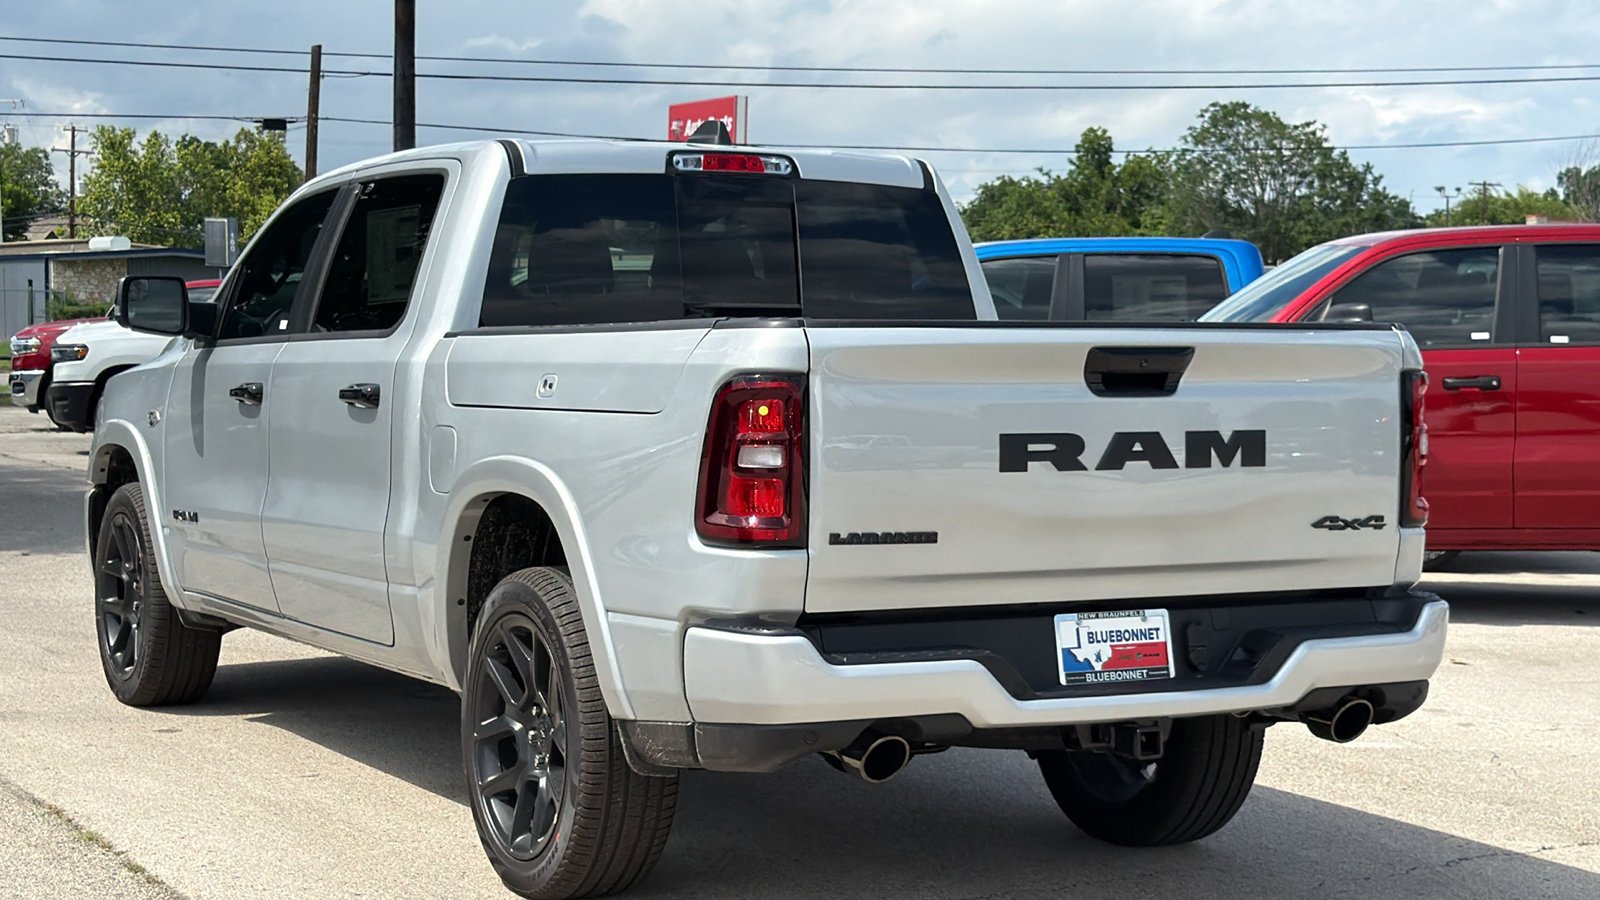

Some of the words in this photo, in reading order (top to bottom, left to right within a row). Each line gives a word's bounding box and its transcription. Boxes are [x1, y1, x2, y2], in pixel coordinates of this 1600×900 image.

[999, 430, 1266, 473] RAM
[1311, 515, 1386, 531] 4x4
[1087, 628, 1160, 644] BLUEBONNET
[1085, 670, 1148, 682] BLUEBONNET
